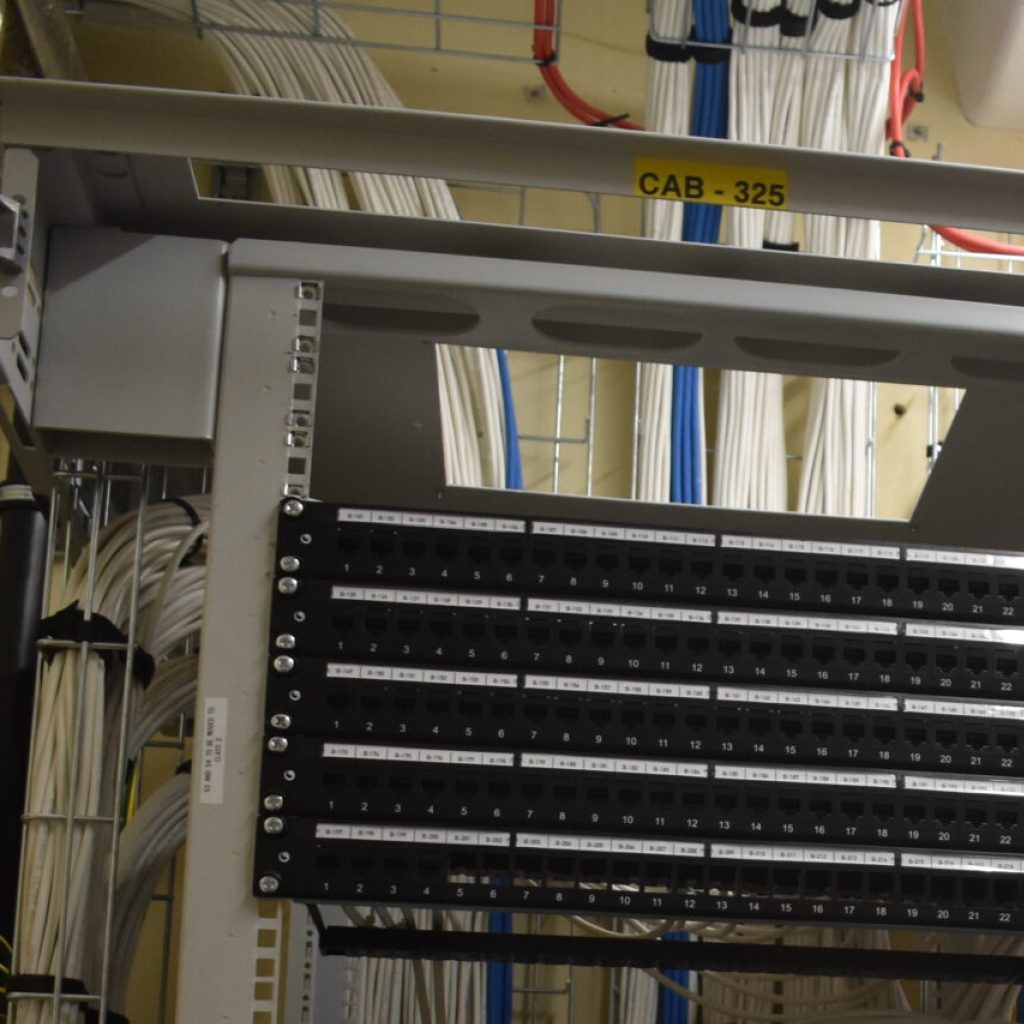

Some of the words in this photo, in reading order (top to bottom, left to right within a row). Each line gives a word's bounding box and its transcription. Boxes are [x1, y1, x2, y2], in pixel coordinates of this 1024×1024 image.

[638, 172, 704, 199] CAB
[734, 180, 785, 206] 325
[344, 563, 349, 572] 1
[376, 565, 383, 574] 2
[409, 567, 416, 576] 3
[474, 571, 481, 580] 5
[506, 573, 513, 582] 6
[539, 575, 545, 583] 7
[570, 577, 577, 586] 8
[602, 579, 609, 588] 9
[632, 582, 644, 590] 10
[665, 584, 674, 592] 11
[696, 586, 706, 595] 12
[727, 588, 738, 597] 13
[758, 590, 769, 598] 14
[789, 592, 800, 601] 15
[820, 594, 831, 603] 16
[852, 596, 862, 604] 17
[882, 598, 893, 607] 18
[913, 600, 924, 609] 19
[942, 602, 954, 611] 20
[972, 604, 983, 613] 21
[1002, 606, 1014, 616] 22
[366, 722, 373, 731] 2
[400, 724, 406, 733] 3
[465, 727, 472, 736] 5
[498, 729, 504, 738] 6
[531, 731, 537, 739] 7
[563, 732, 570, 742] 8
[595, 735, 602, 744] 9
[626, 736, 637, 746] 10
[659, 739, 668, 747] 11
[690, 740, 701, 750] 12
[722, 742, 733, 751] 13
[754, 744, 764, 752] 14
[785, 746, 796, 754] 15
[817, 748, 828, 756] 16
[848, 749, 858, 757] 17
[879, 751, 890, 760] 18
[910, 753, 921, 762] 19
[940, 754, 952, 764] 20
[970, 756, 981, 765] 21
[1001, 758, 1013, 767] 22
[324, 882, 329, 890] 1
[356, 884, 363, 892] 2
[390, 885, 397, 894] 3
[423, 887, 430, 895] 4
[457, 888, 464, 897] 5
[490, 889, 497, 898] 6
[524, 890, 530, 899] 7
[556, 892, 562, 901] 8
[588, 894, 596, 903] 9
[619, 896, 631, 905] 10
[653, 898, 662, 906] 11
[684, 899, 696, 908] 12
[716, 900, 728, 910] 13
[749, 902, 760, 910] 14
[781, 903, 792, 912] 15
[813, 904, 824, 914] 16
[844, 906, 855, 914] 17
[876, 907, 886, 916] 18
[907, 908, 918, 917] 19
[938, 910, 949, 919] 20
[968, 911, 979, 920] 21
[1000, 913, 1010, 922] 22
